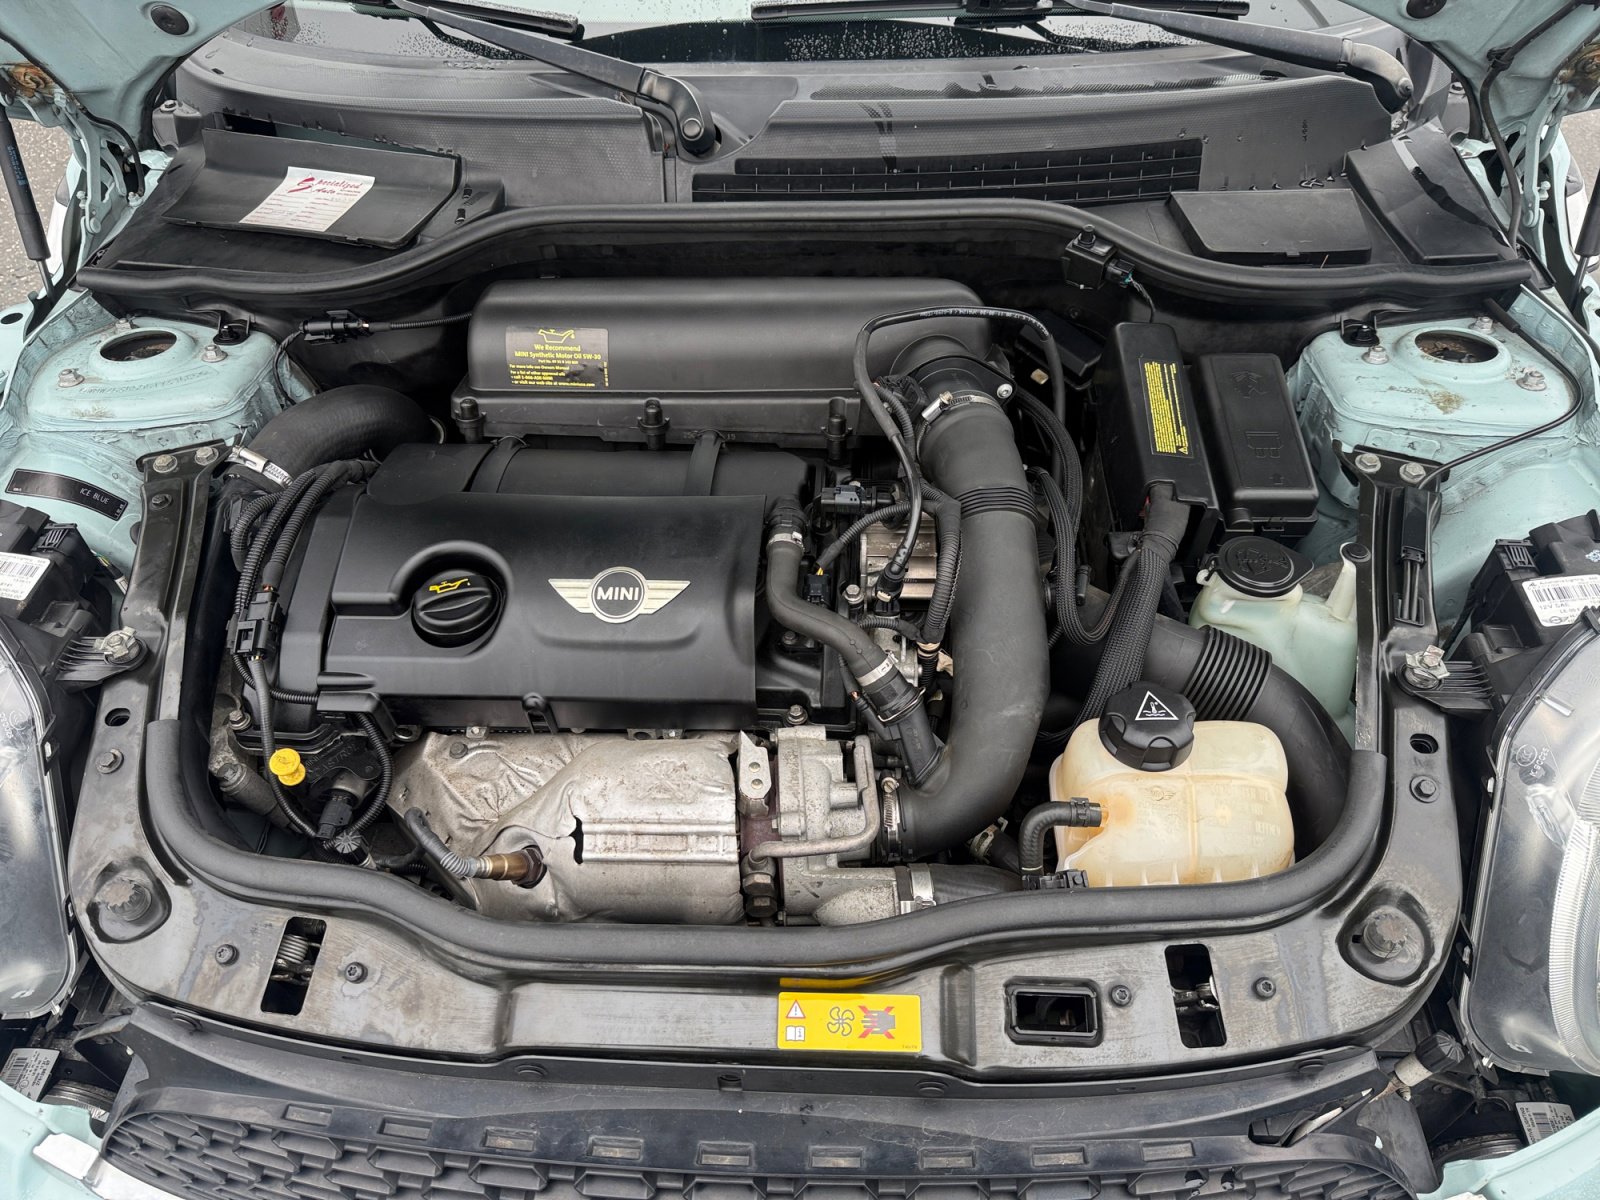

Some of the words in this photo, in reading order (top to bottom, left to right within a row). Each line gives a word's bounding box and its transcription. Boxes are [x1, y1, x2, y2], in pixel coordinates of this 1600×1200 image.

[80, 487, 90, 496] ICE
[93, 493, 110, 504] BLUE
[596, 586, 639, 600] MINI
